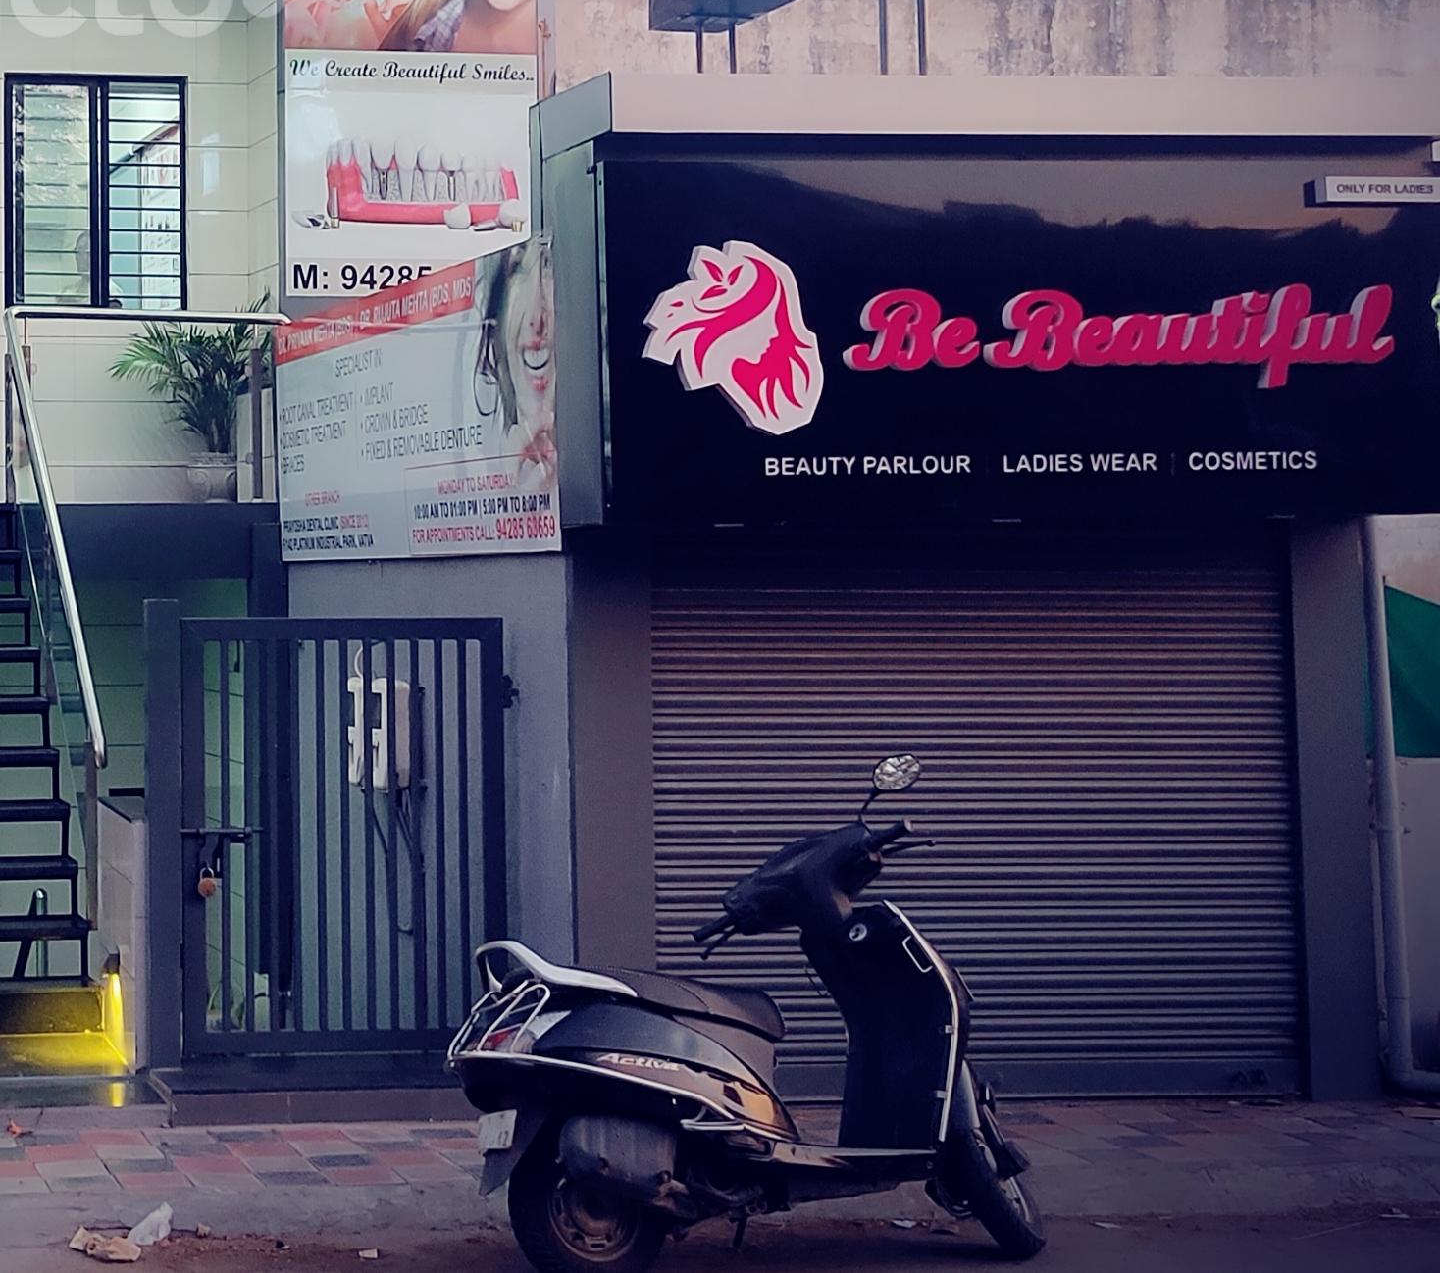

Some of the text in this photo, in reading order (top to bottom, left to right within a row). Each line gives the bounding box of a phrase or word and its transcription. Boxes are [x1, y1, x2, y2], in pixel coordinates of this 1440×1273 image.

[289, 59, 320, 76] We
[325, 60, 378, 78] Create
[383, 61, 466, 84] Beautiful
[1336, 183, 1434, 195] ONLY FOR LADIES
[293, 264, 329, 290] M:
[401, 291, 429, 319] MEHTA
[843, 283, 1396, 389] Be Beautiful
[440, 424, 484, 452] DENTURE
[764, 450, 1317, 476] BEAUTY PARLOUR LADIES WEAR COSMETICS
[497, 496, 508, 513] PM
[509, 495, 520, 513] TO
[539, 493, 550, 511] PM
[596, 1053, 679, 1071] Activa
